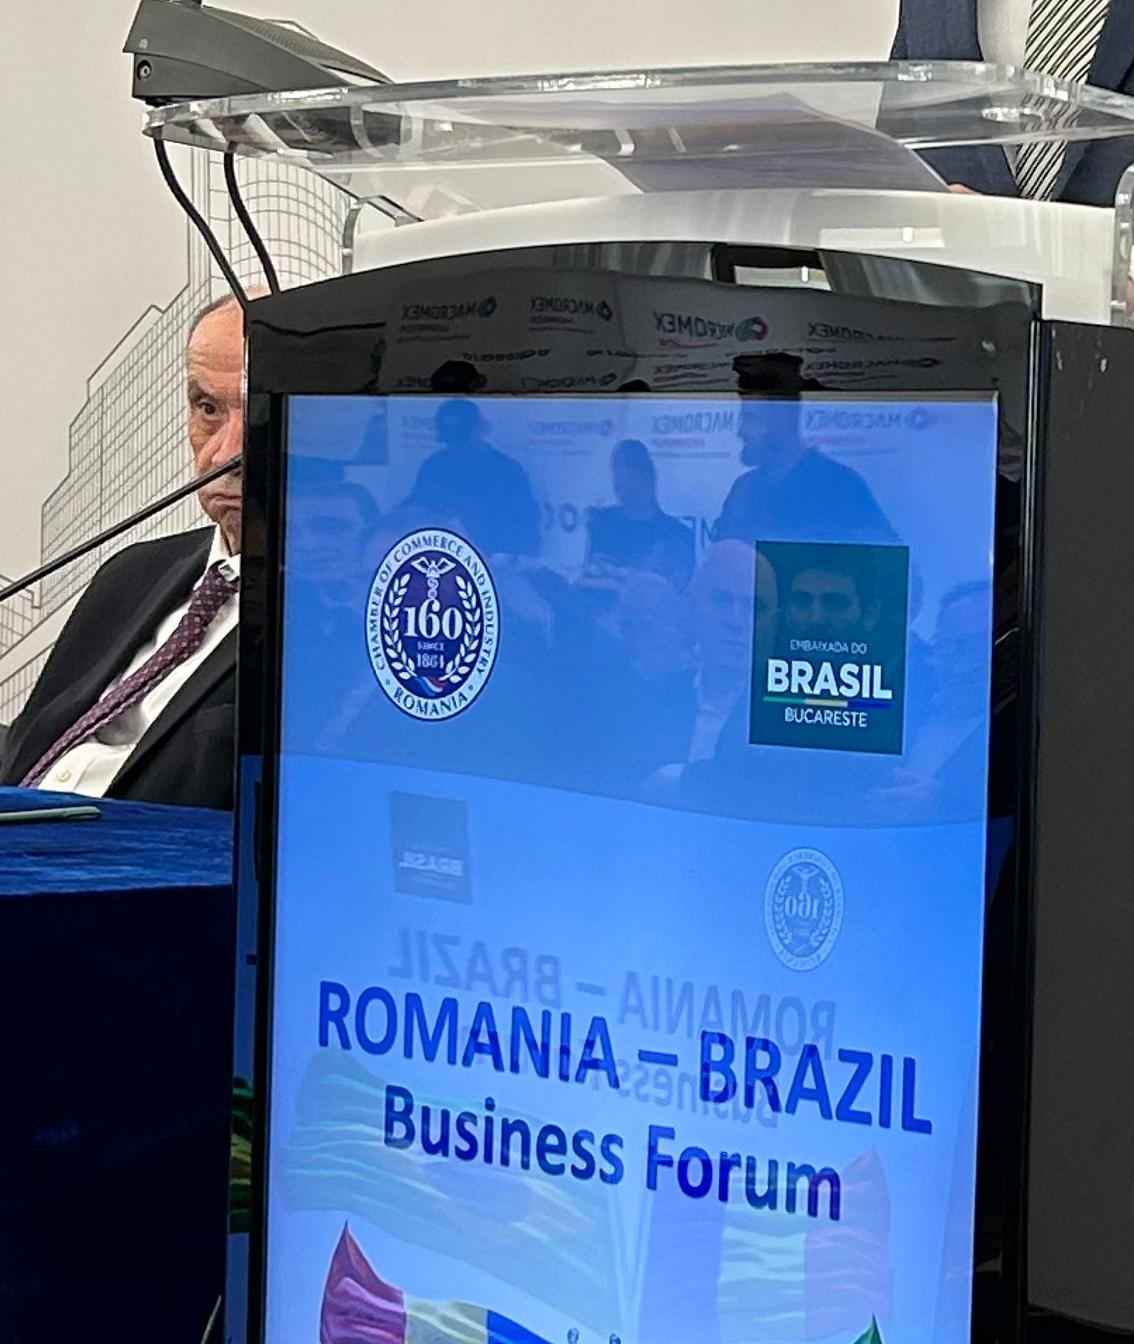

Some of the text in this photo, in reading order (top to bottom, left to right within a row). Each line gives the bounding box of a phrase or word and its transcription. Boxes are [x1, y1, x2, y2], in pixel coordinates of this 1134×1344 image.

[394, 535, 463, 563] COMMERCE
[463, 556, 486, 586] AND
[476, 589, 495, 674] INDUSTRY
[403, 599, 463, 640] 160
[851, 642, 868, 655] DO
[767, 659, 893, 700] BRASIL
[393, 687, 468, 716] ROMANIA
[785, 706, 868, 728] BUCARESTE
[318, 980, 621, 1089] ROMANIA
[701, 1031, 933, 1135] BRAZIL
[383, 1085, 842, 1222] Business Forum
